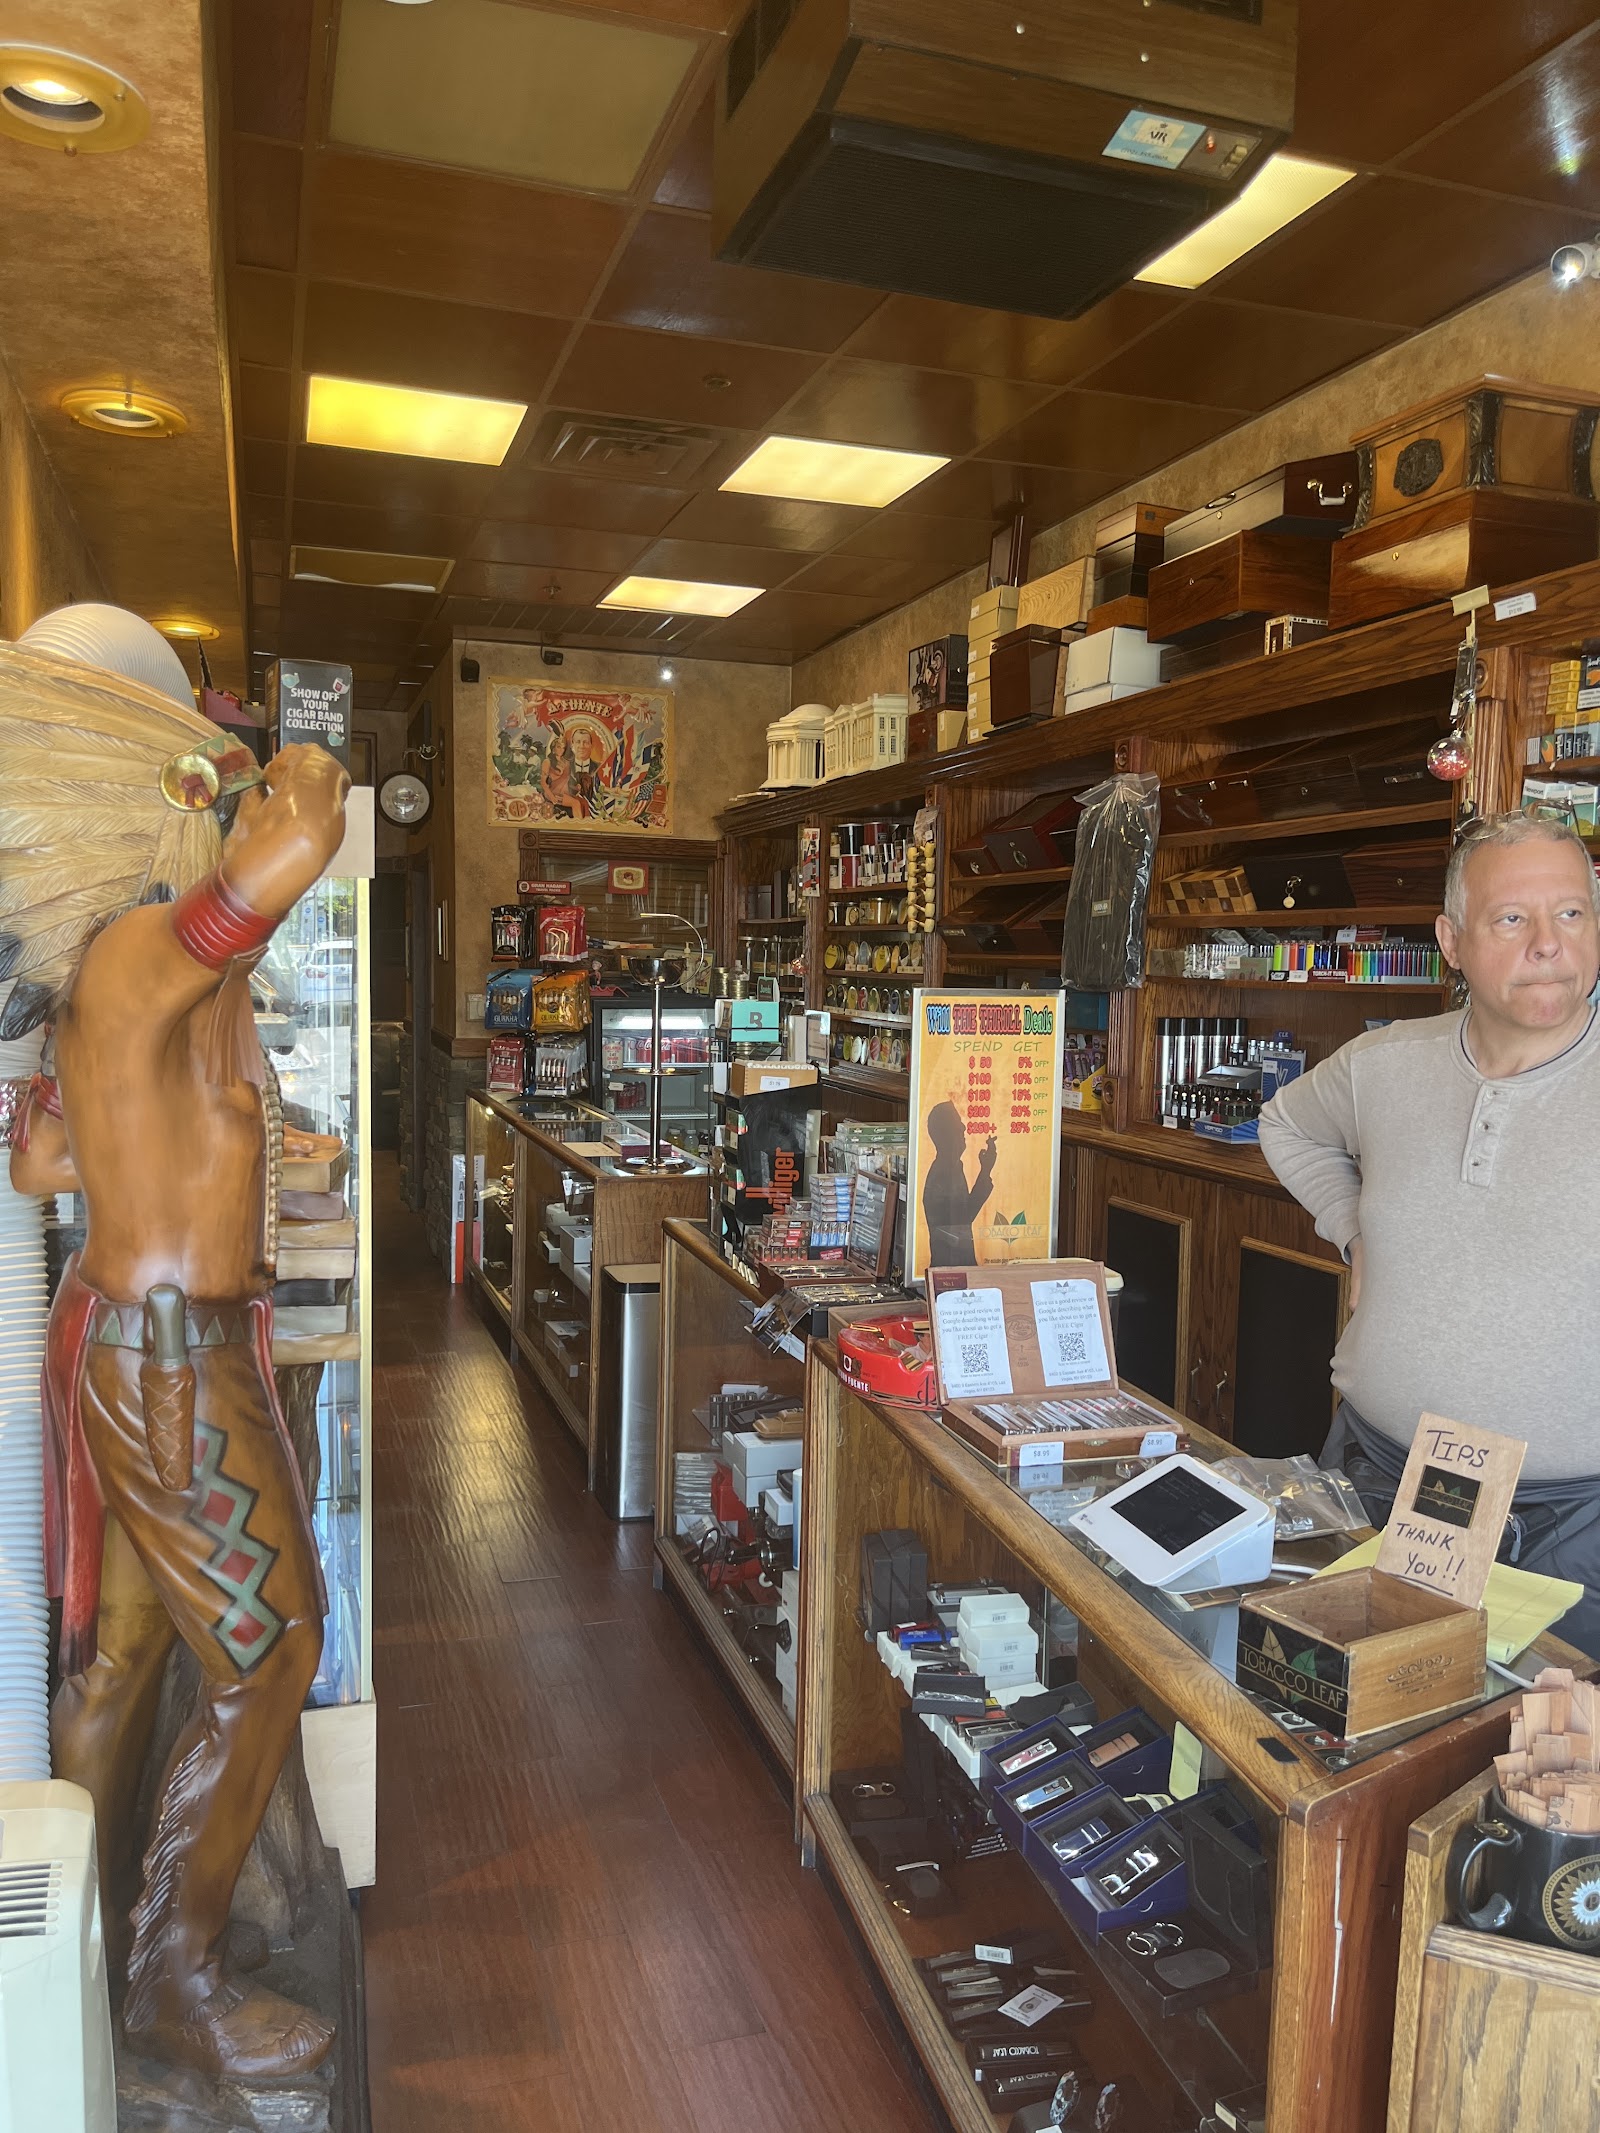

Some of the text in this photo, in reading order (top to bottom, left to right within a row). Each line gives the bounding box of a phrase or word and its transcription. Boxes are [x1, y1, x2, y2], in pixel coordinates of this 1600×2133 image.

[291, 688, 340, 701] SHOW OFF
[302, 699, 329, 710] YOUR
[287, 708, 344, 723] CIGAR BAND
[286, 718, 344, 733] COLLECTION
[1525, 786, 1544, 796] Newport
[494, 1015, 518, 1023] GURKHA
[926, 1004, 1053, 1035] Will THE THRILL Deals
[953, 1040, 1042, 1053] SPEND GET
[969, 1055, 975, 1069] $
[980, 1056, 992, 1069] 50
[1018, 1056, 1032, 1068] 5%
[968, 1072, 991, 1086] $100
[1012, 1072, 1032, 1085] 10%
[967, 1088, 991, 1102] $150
[1012, 1088, 1032, 1101] 15%
[967, 1105, 990, 1119] $200
[1011, 1105, 1031, 1118] 20%
[966, 1121, 997, 1135] $250+
[1010, 1122, 1030, 1134] 25%
[978, 1226, 1042, 1238] TOBACCO LEAF
[1038, 1307, 1057, 1315] Google
[961, 1316, 987, 1324] describing
[847, 1376, 869, 1392] FUENTE
[1427, 1429, 1489, 1468] TIPS
[1397, 1522, 1455, 1550] THANK
[1243, 1647, 1345, 1709] TOBACCO LEAF
[1008, 2046, 1039, 2056] TOBACCO
